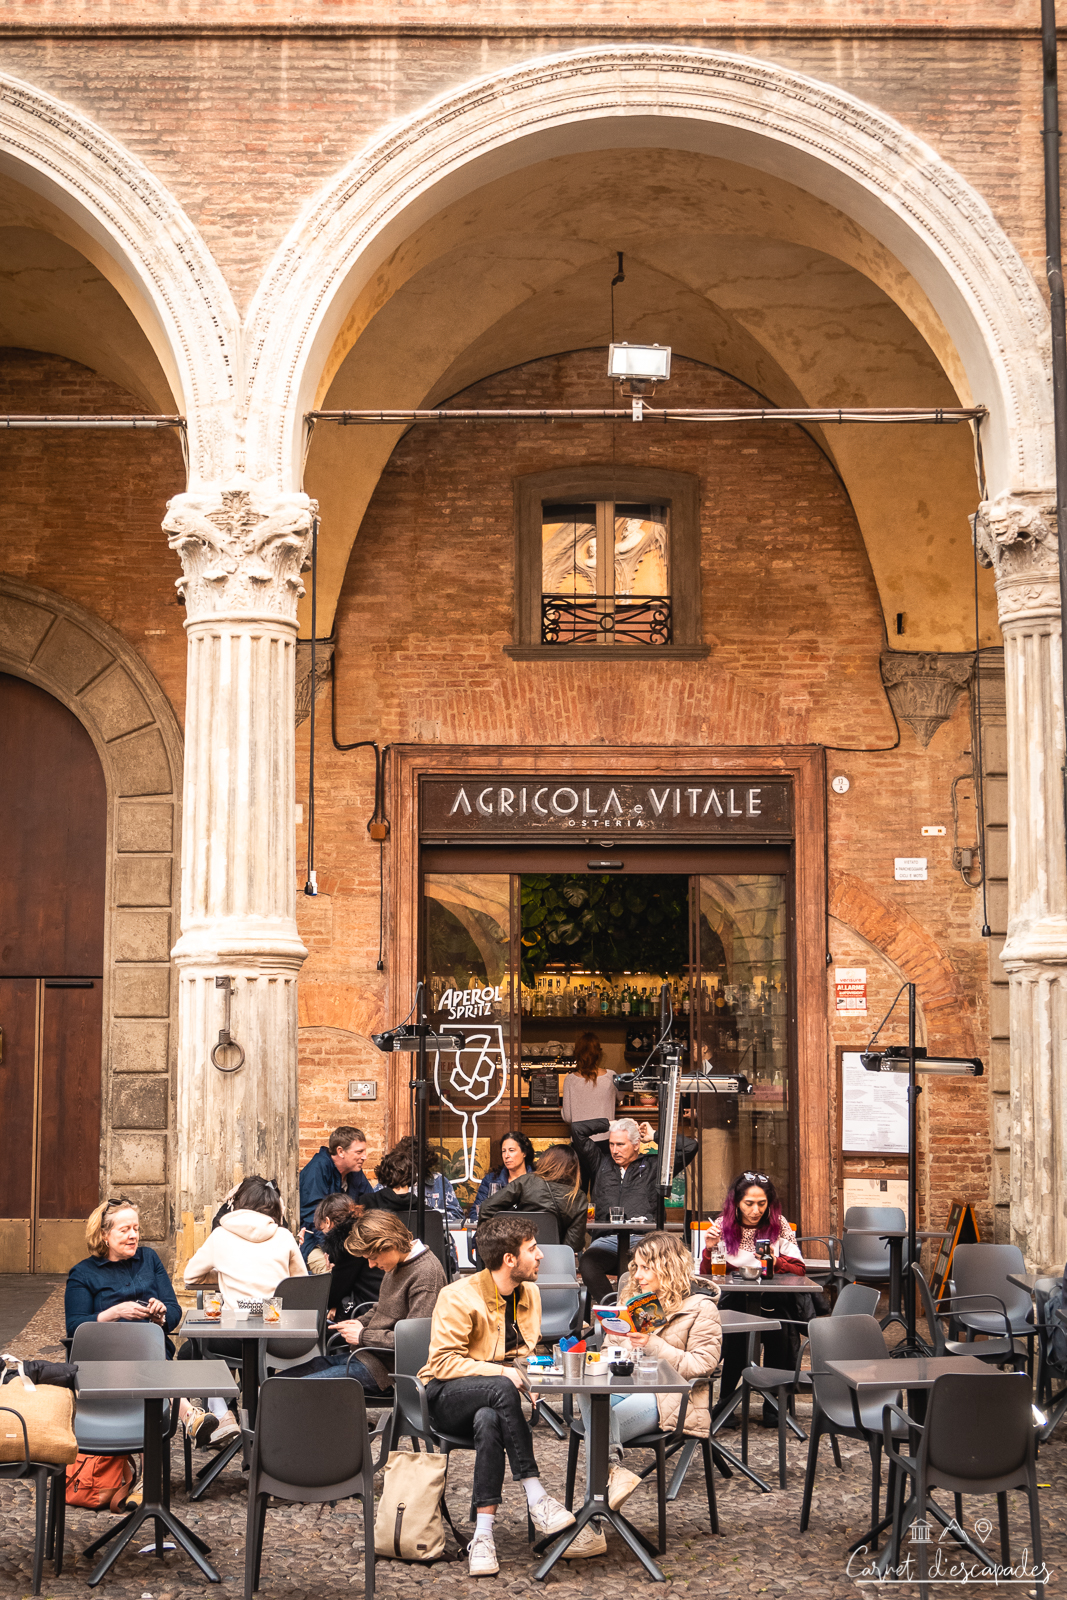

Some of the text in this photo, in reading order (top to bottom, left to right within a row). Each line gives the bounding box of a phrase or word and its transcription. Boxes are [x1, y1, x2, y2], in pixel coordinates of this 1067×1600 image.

[450, 787, 762, 816] AGRICOLA e VITALE
[568, 819, 644, 828] OSTERIA
[438, 986, 503, 1011] APEROL
